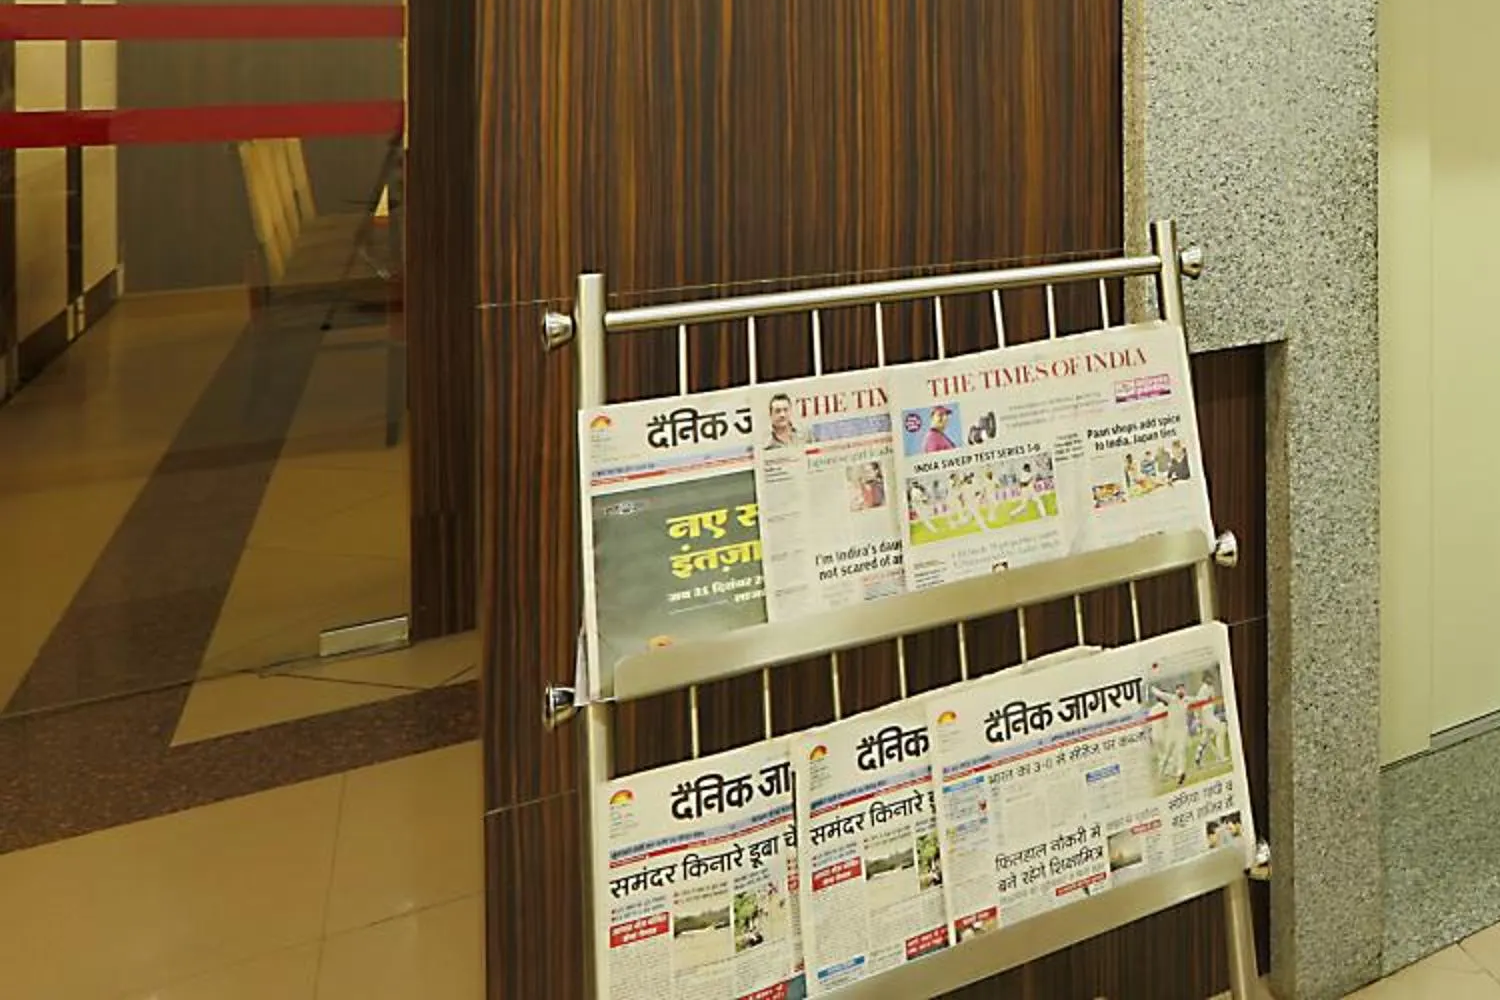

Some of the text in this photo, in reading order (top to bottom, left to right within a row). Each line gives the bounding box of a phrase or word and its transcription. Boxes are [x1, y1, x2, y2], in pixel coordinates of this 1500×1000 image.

[928, 347, 1147, 397] THE TIMES OF INDIA
[647, 407, 729, 449] दैनिक
[796, 393, 847, 418] THE
[665, 508, 728, 539] नए
[819, 566, 838, 580] not
[841, 557, 879, 577] scared
[984, 701, 1053, 743] दैनिक
[1057, 677, 1143, 723] जागरण
[856, 725, 931, 771] दैनिक
[670, 773, 753, 820] दैनिक
[809, 812, 867, 846] समंदर
[868, 789, 925, 827] किनारे
[609, 864, 678, 899] समंदर
[682, 843, 745, 880] किनारे
